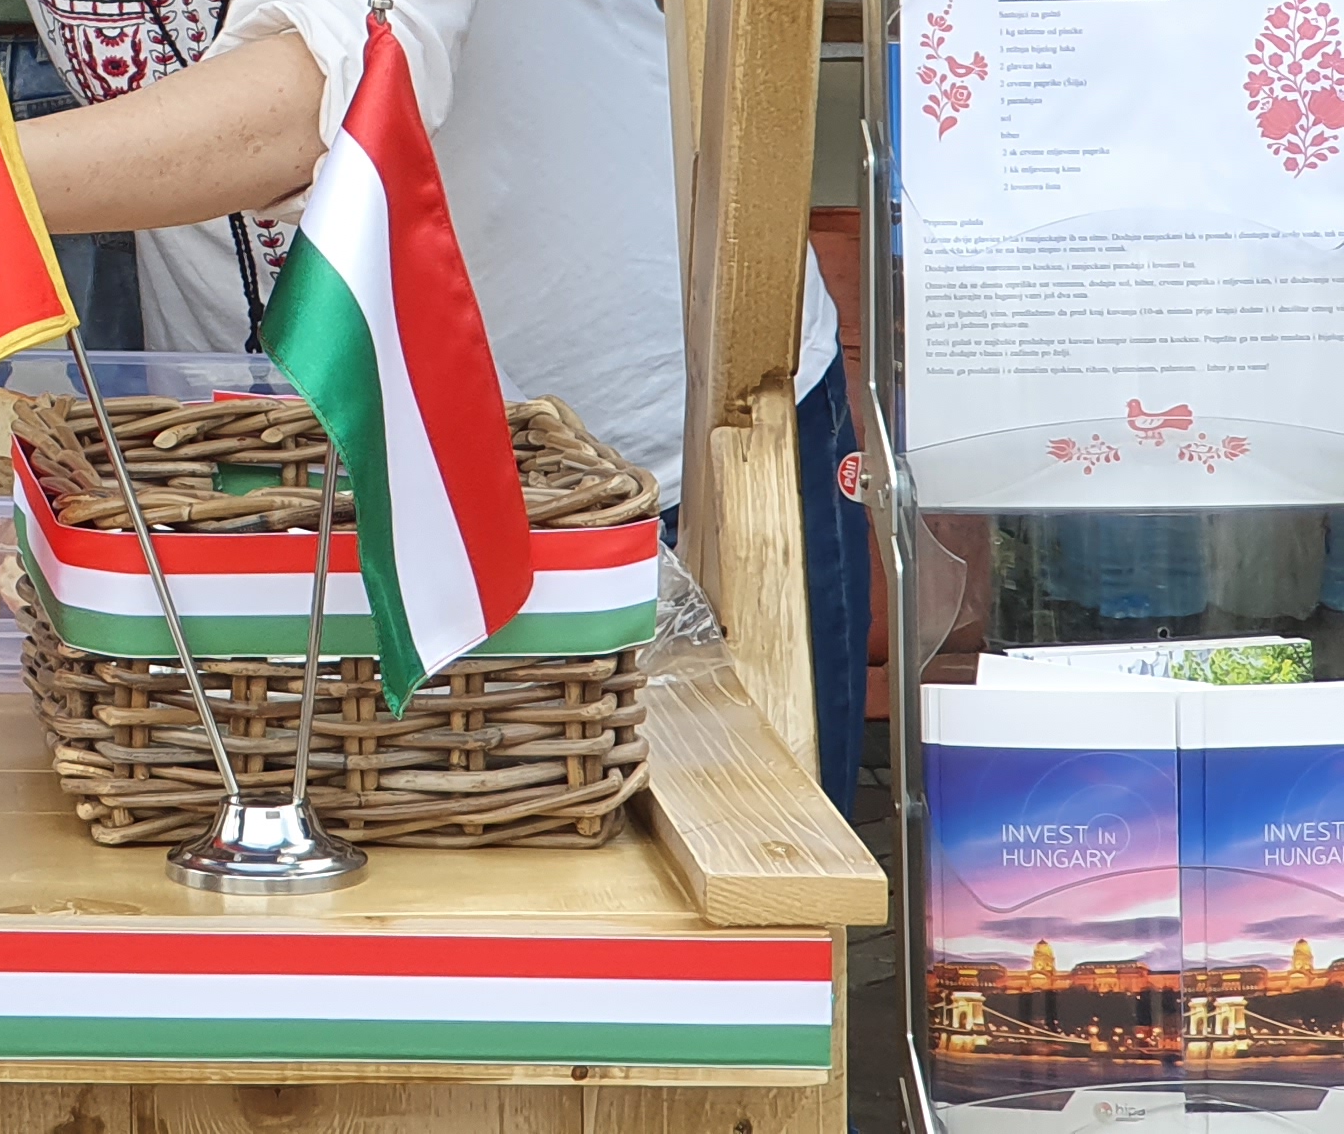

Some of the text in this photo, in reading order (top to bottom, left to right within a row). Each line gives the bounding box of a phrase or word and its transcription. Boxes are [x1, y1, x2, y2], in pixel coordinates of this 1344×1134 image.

[1001, 824, 1089, 845] INVEST
[1264, 821, 1344, 843] INVEST
[1002, 848, 1117, 869] HUNGARY
[1264, 845, 1344, 867] HUNGA
